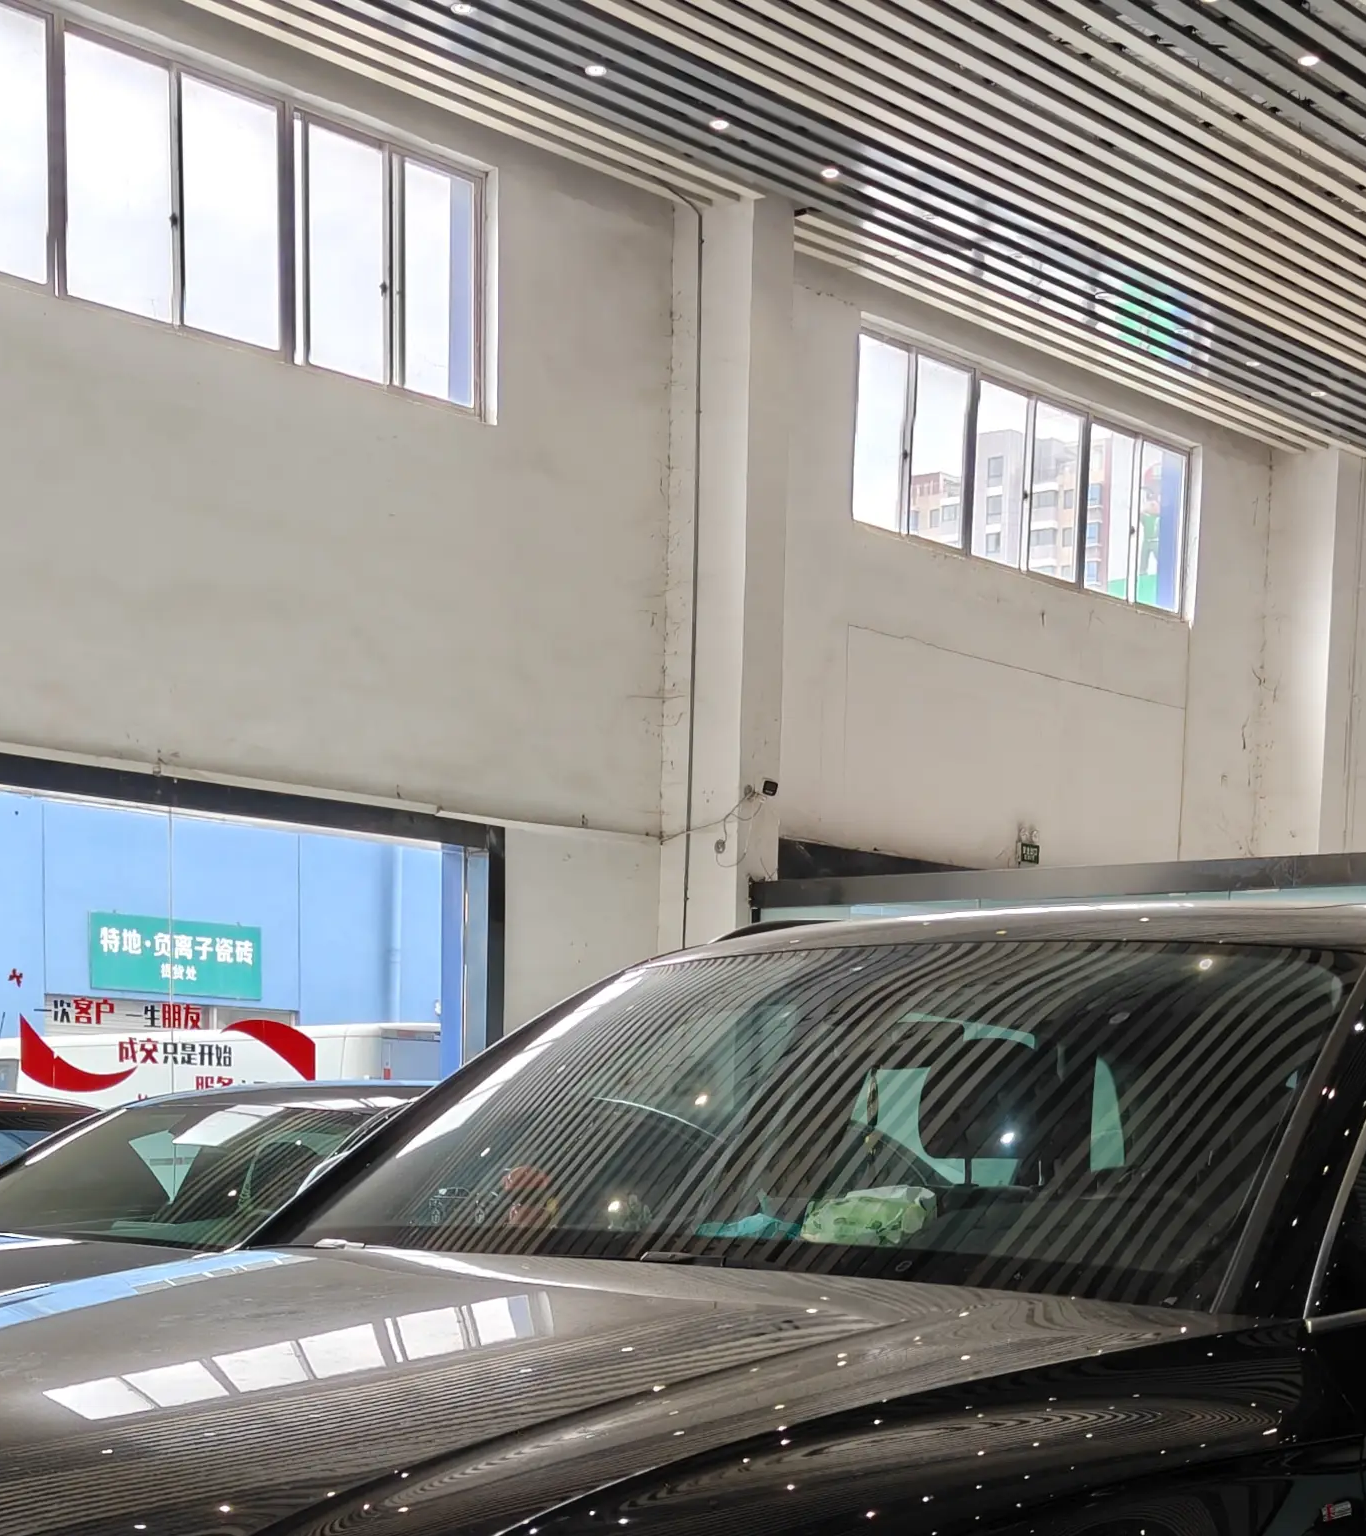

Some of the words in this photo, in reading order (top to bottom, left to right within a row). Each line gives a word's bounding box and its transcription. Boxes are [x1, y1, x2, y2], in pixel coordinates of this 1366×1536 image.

[118, 1037, 233, 1068] 成交只是开始
